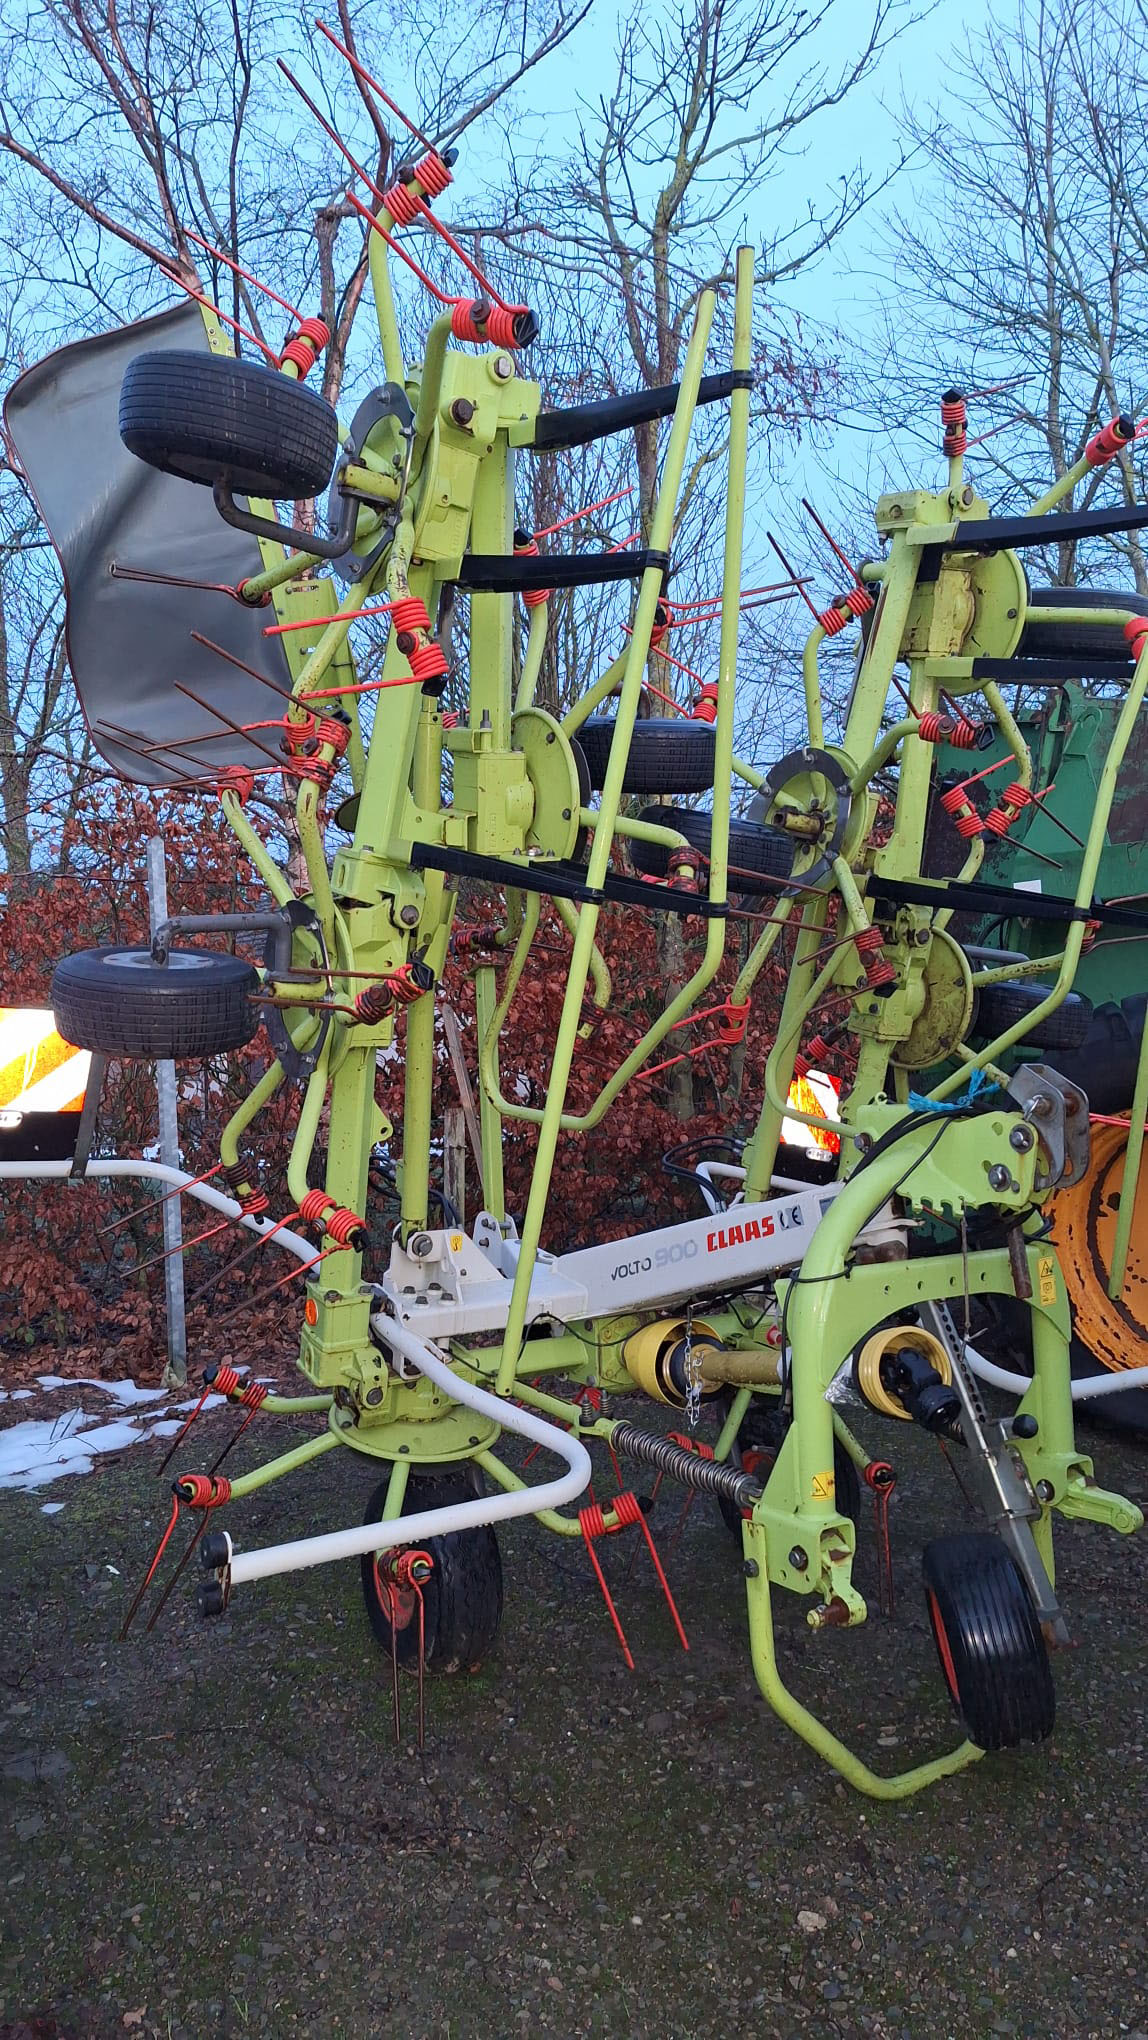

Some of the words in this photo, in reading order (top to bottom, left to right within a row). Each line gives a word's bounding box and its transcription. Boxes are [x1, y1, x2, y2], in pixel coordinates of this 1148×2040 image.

[611, 1257, 652, 1281] VOLTO
[656, 1239, 699, 1268] 900
[707, 1216, 775, 1252] CLAAS
